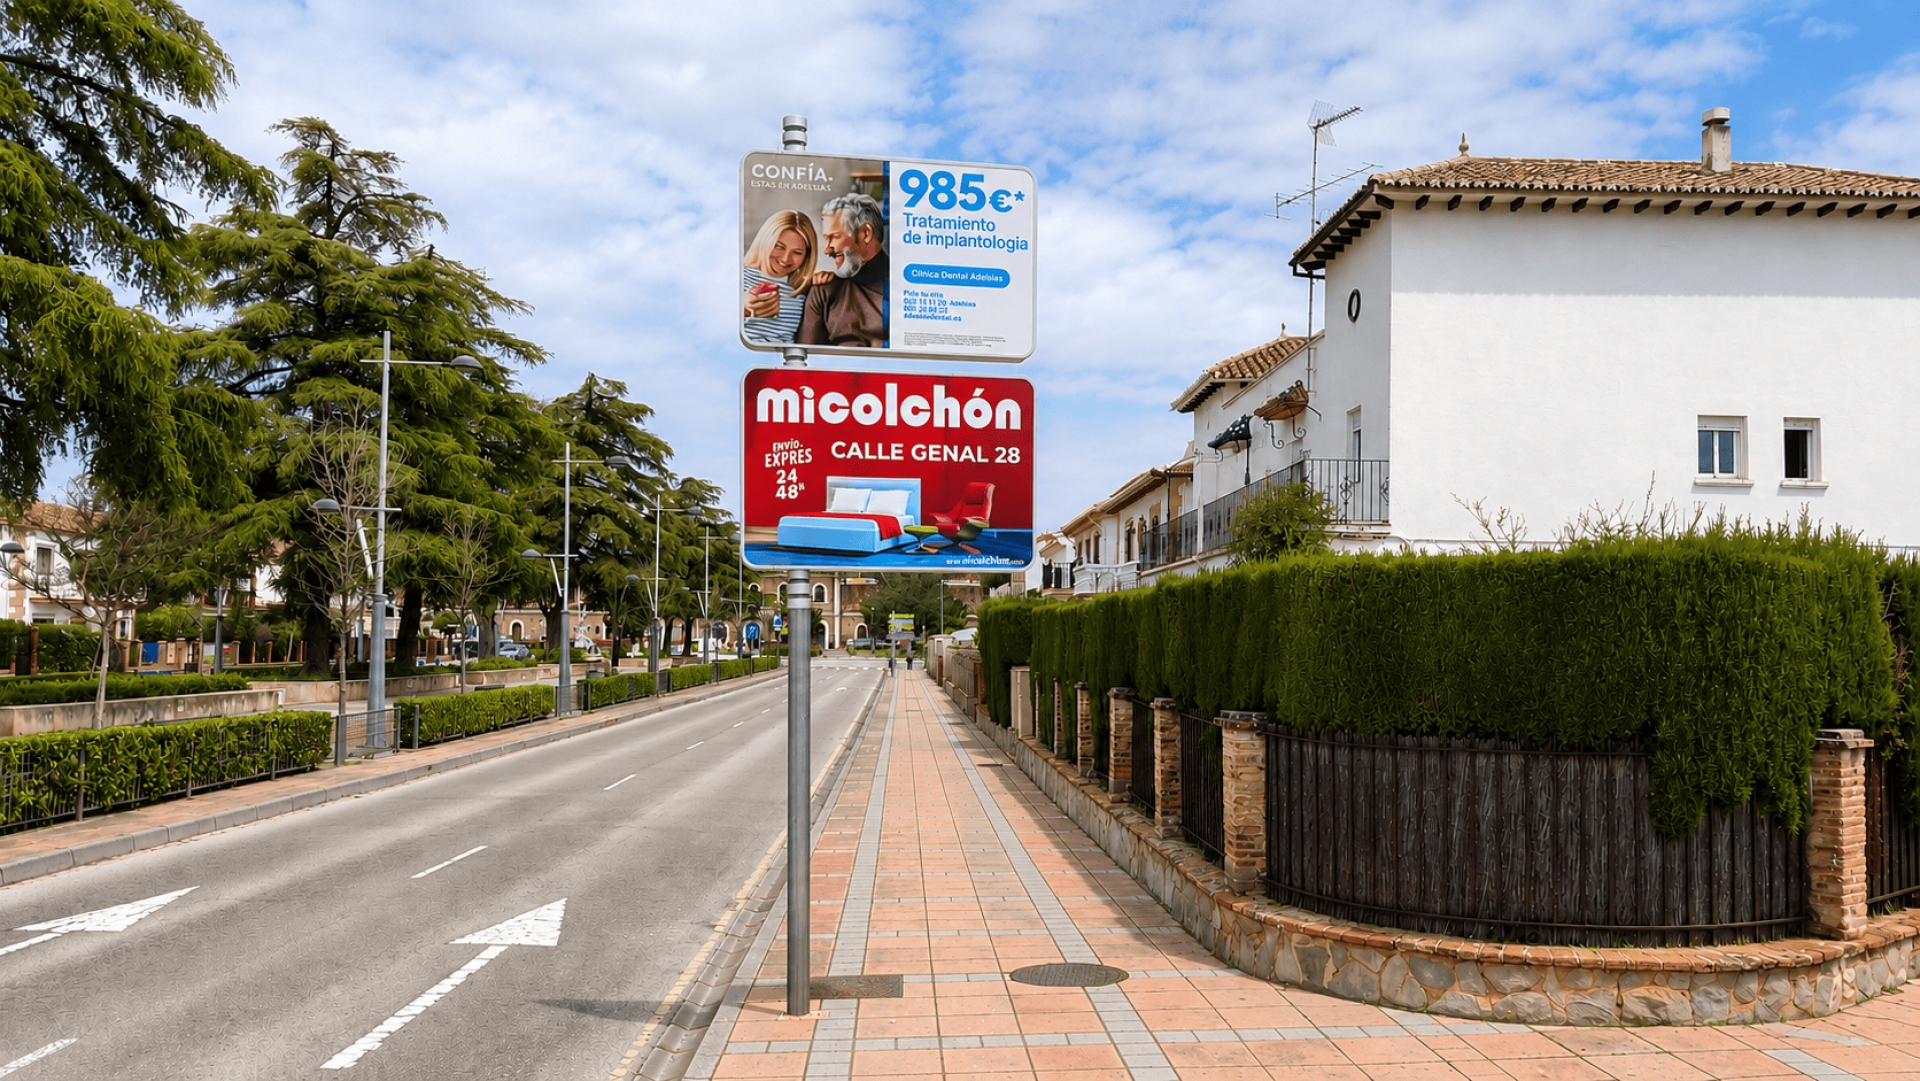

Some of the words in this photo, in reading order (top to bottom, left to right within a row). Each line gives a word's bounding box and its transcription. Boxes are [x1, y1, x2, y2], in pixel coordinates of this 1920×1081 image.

[902, 212, 996, 232] Tratamiento
[902, 230, 922, 244] de
[926, 231, 1029, 253] implantologia
[756, 382, 1021, 430] micolchón
[765, 448, 813, 468] EXPRES
[831, 441, 904, 461] CALLE
[911, 443, 989, 464] GENAL
[994, 446, 1021, 464] 28
[776, 468, 798, 484] 24
